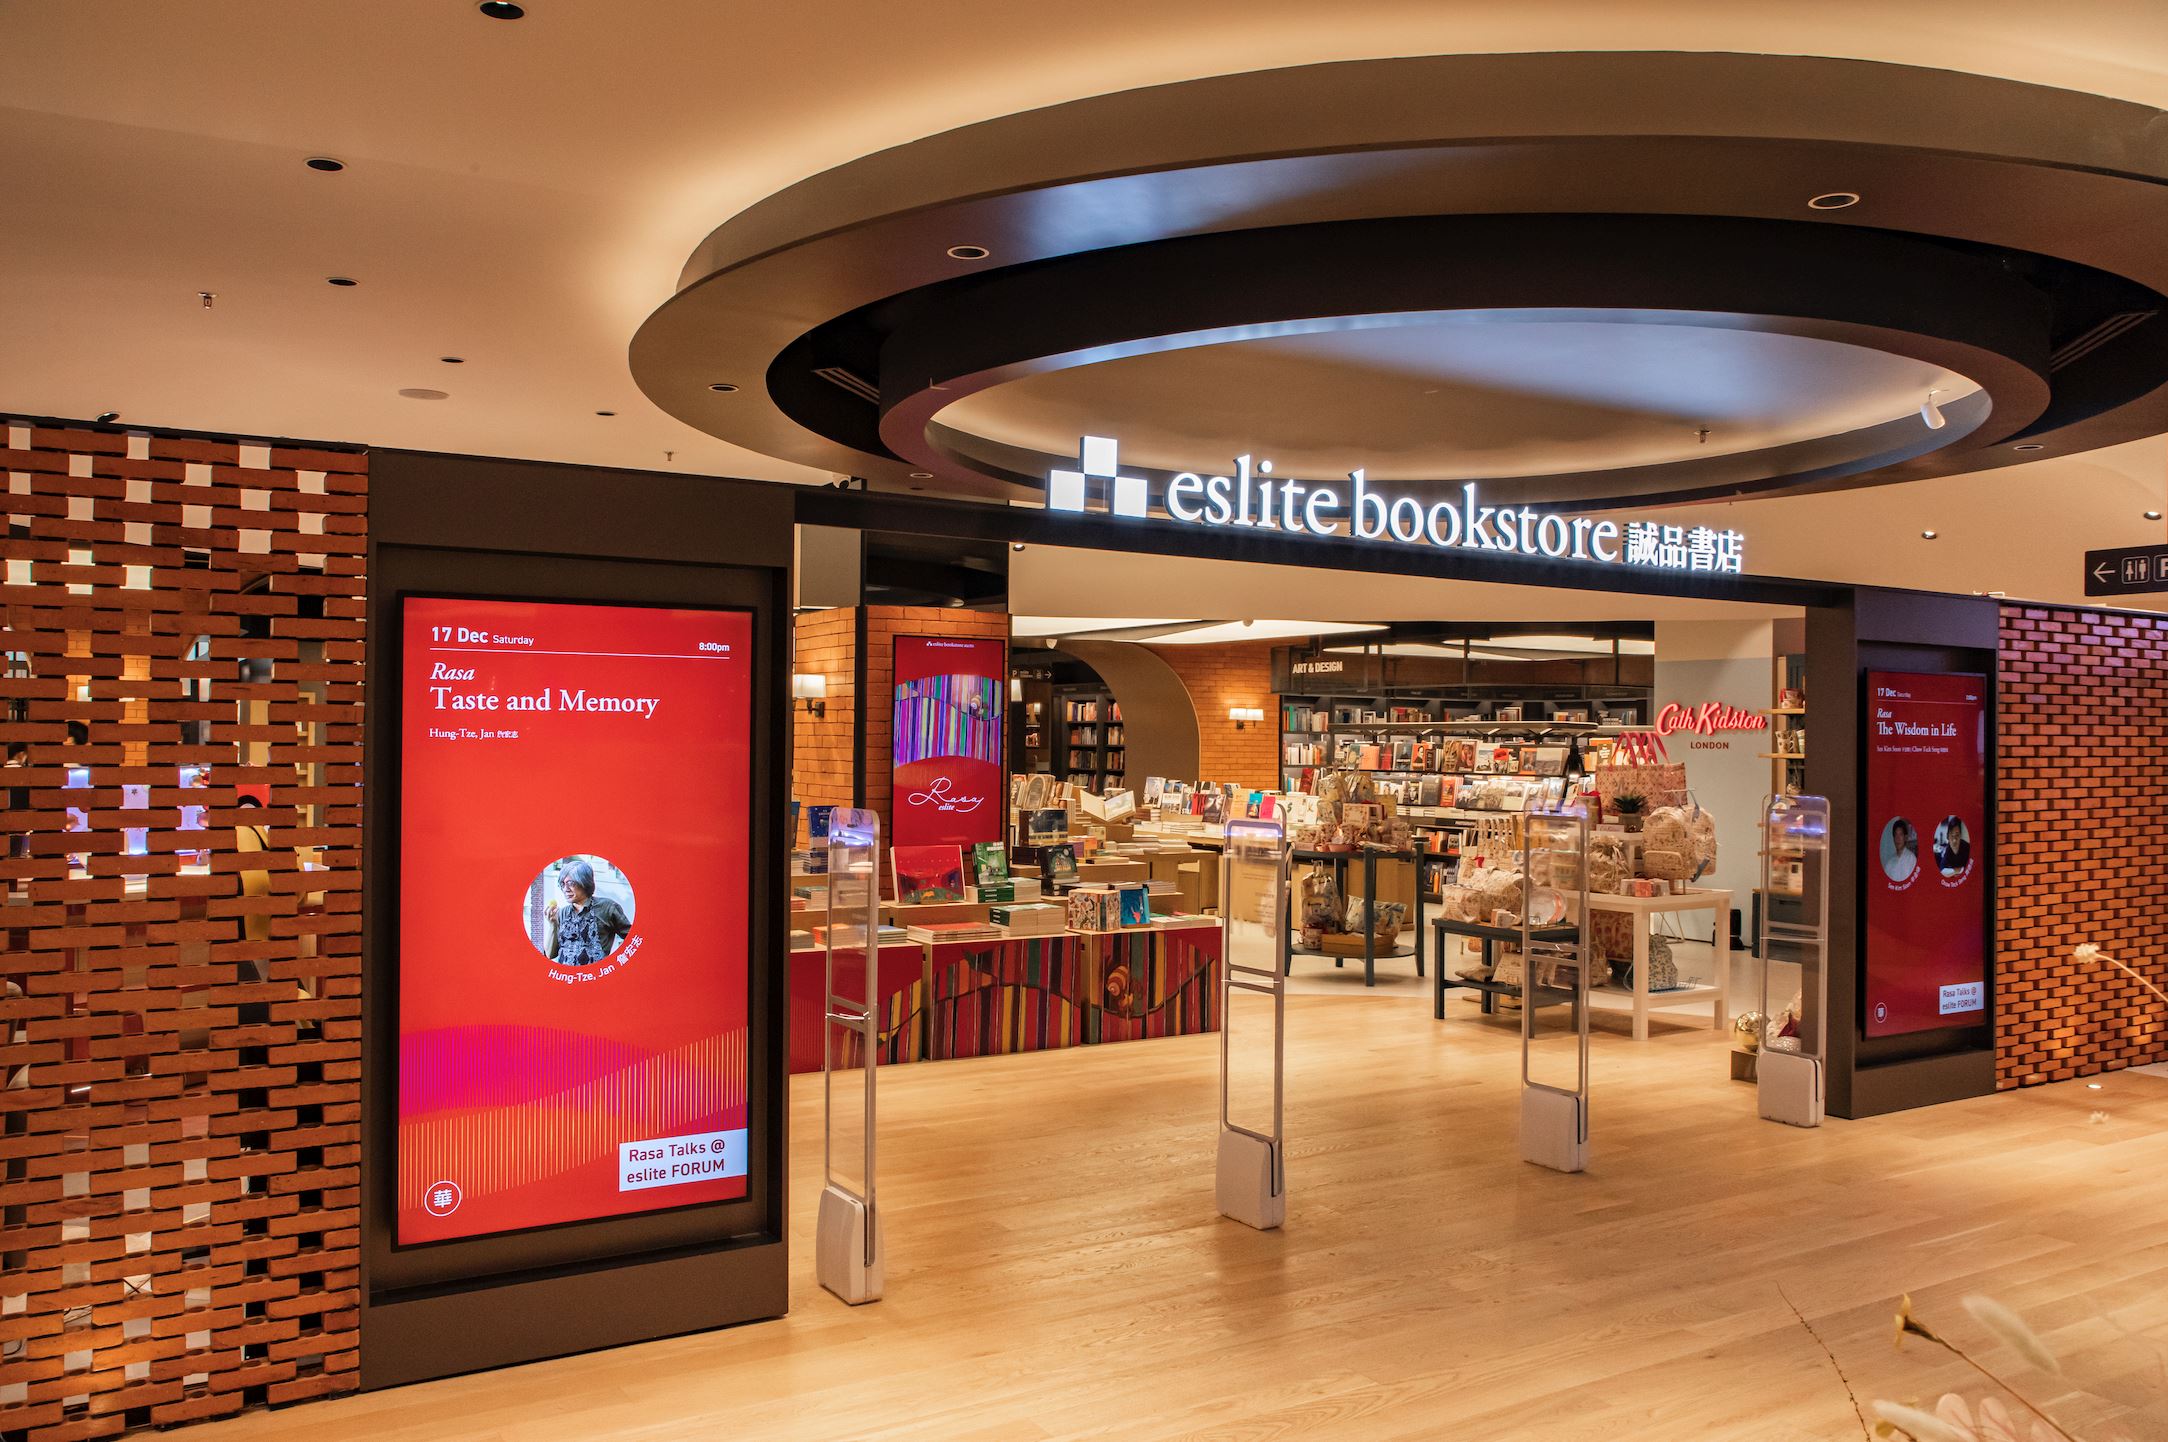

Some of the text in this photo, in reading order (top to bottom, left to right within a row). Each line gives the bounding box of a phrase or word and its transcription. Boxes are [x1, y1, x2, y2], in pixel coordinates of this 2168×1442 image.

[1165, 453, 1618, 562] eslite bookstore
[1624, 520, 1745, 574] 誠品書店
[431, 626, 535, 647] 17 Dec Saturday
[698, 641, 730, 653] 8:00pm
[429, 662, 475, 681] Rasa
[1292, 661, 1343, 674] ART & DESIGN
[429, 686, 660, 719] Taste and Memory
[1885, 687, 1896, 697] Dec
[1655, 701, 1767, 736] Cath Kidston
[1876, 721, 1957, 737] The Wisdom in Life
[429, 728, 478, 740] Hung-Tze,
[479, 728, 495, 740] Jan
[1690, 742, 1729, 750] LONDON
[938, 803, 955, 811] eslite
[548, 964, 615, 985] Hung-Tze, Jan
[629, 1139, 725, 1162] Rasa Talks @
[627, 1158, 725, 1183] eslite FORUM
[433, 1188, 453, 1209] 華
